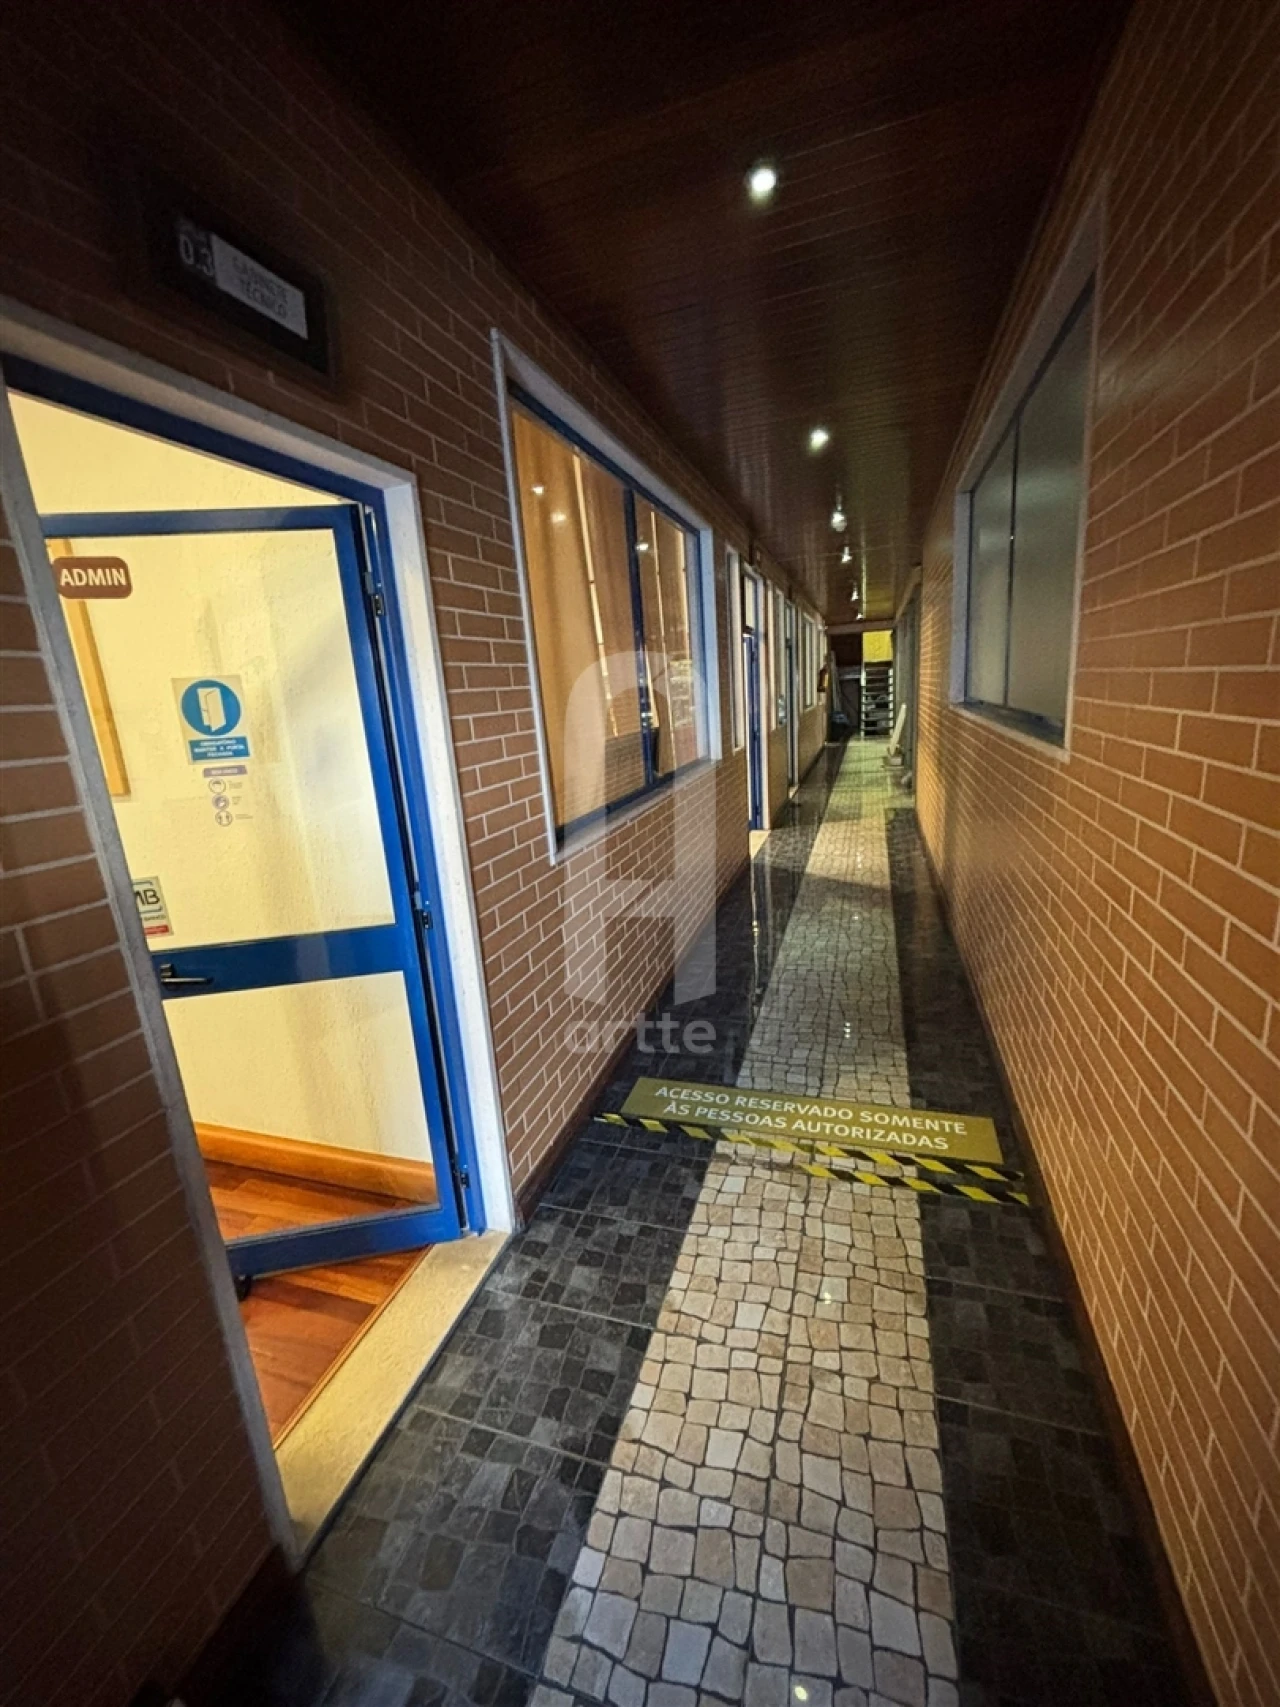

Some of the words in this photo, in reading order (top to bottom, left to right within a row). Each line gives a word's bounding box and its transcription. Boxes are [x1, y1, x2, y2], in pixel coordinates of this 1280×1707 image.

[60, 568, 127, 586] ADMIN
[654, 1086, 731, 1105] ACESSO
[734, 1095, 854, 1120] RESERVADO
[859, 1110, 968, 1136] SOMENTE
[694, 1107, 788, 1128] PESSOAS
[791, 1119, 949, 1150] AUTORIZADAS
